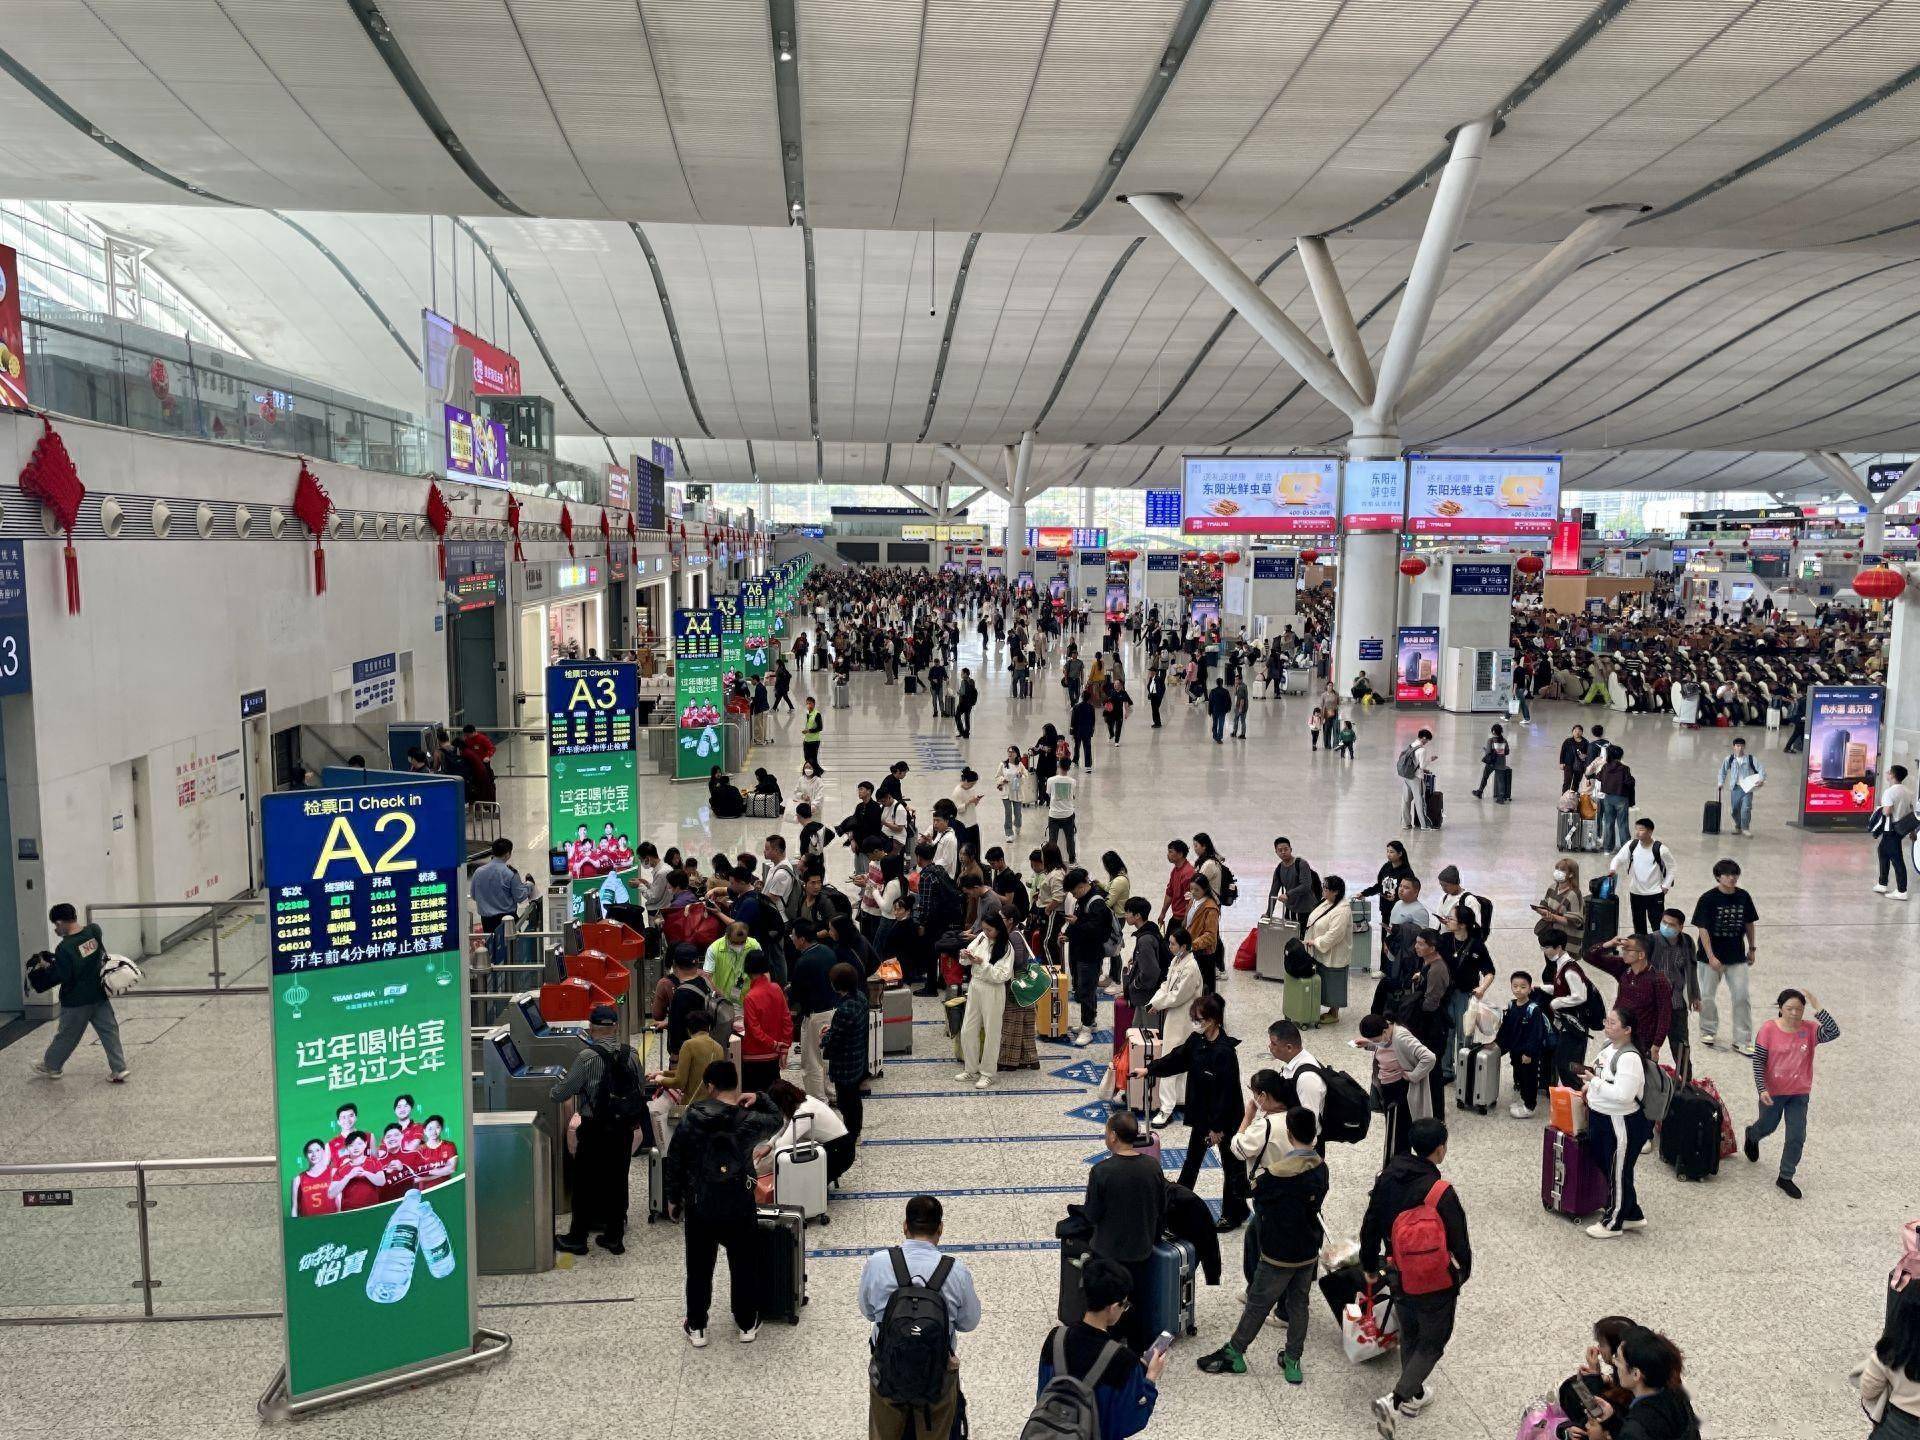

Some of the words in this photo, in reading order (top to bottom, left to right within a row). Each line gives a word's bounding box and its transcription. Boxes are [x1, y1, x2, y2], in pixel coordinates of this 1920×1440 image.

[1371, 472, 1398, 485] 东阳光
[1202, 483, 1273, 496] 东阳光鲜虫草
[1370, 486, 1398, 499] 鲜虫草
[1426, 484, 1496, 497] 东阳光鲜虫草
[747, 585, 763, 596] A6
[717, 601, 737, 616] A5
[685, 616, 712, 635] A4
[0, 635, 19, 677] 3
[589, 669, 612, 677] Check
[612, 668, 619, 676] in
[568, 677, 617, 711] A3
[559, 785, 629, 804] 过年喝怡宝
[303, 797, 354, 817] 检票口
[358, 794, 405, 810] Check
[409, 793, 422, 806] in
[559, 799, 629, 817] 一起过大年
[312, 811, 418, 880] A2
[281, 886, 302, 897] 车次
[371, 876, 392, 888] 开点
[370, 902, 397, 915] 10:31
[371, 929, 398, 941] 11:06
[290, 935, 444, 971] 开车前4分钟停止检票
[332, 993, 353, 1003] TEAM
[353, 990, 376, 1000] CHINA
[296, 1019, 445, 1069] 过年喝怡宝
[296, 1046, 446, 1092] 一起过大年
[311, 1192, 322, 1208] 5
